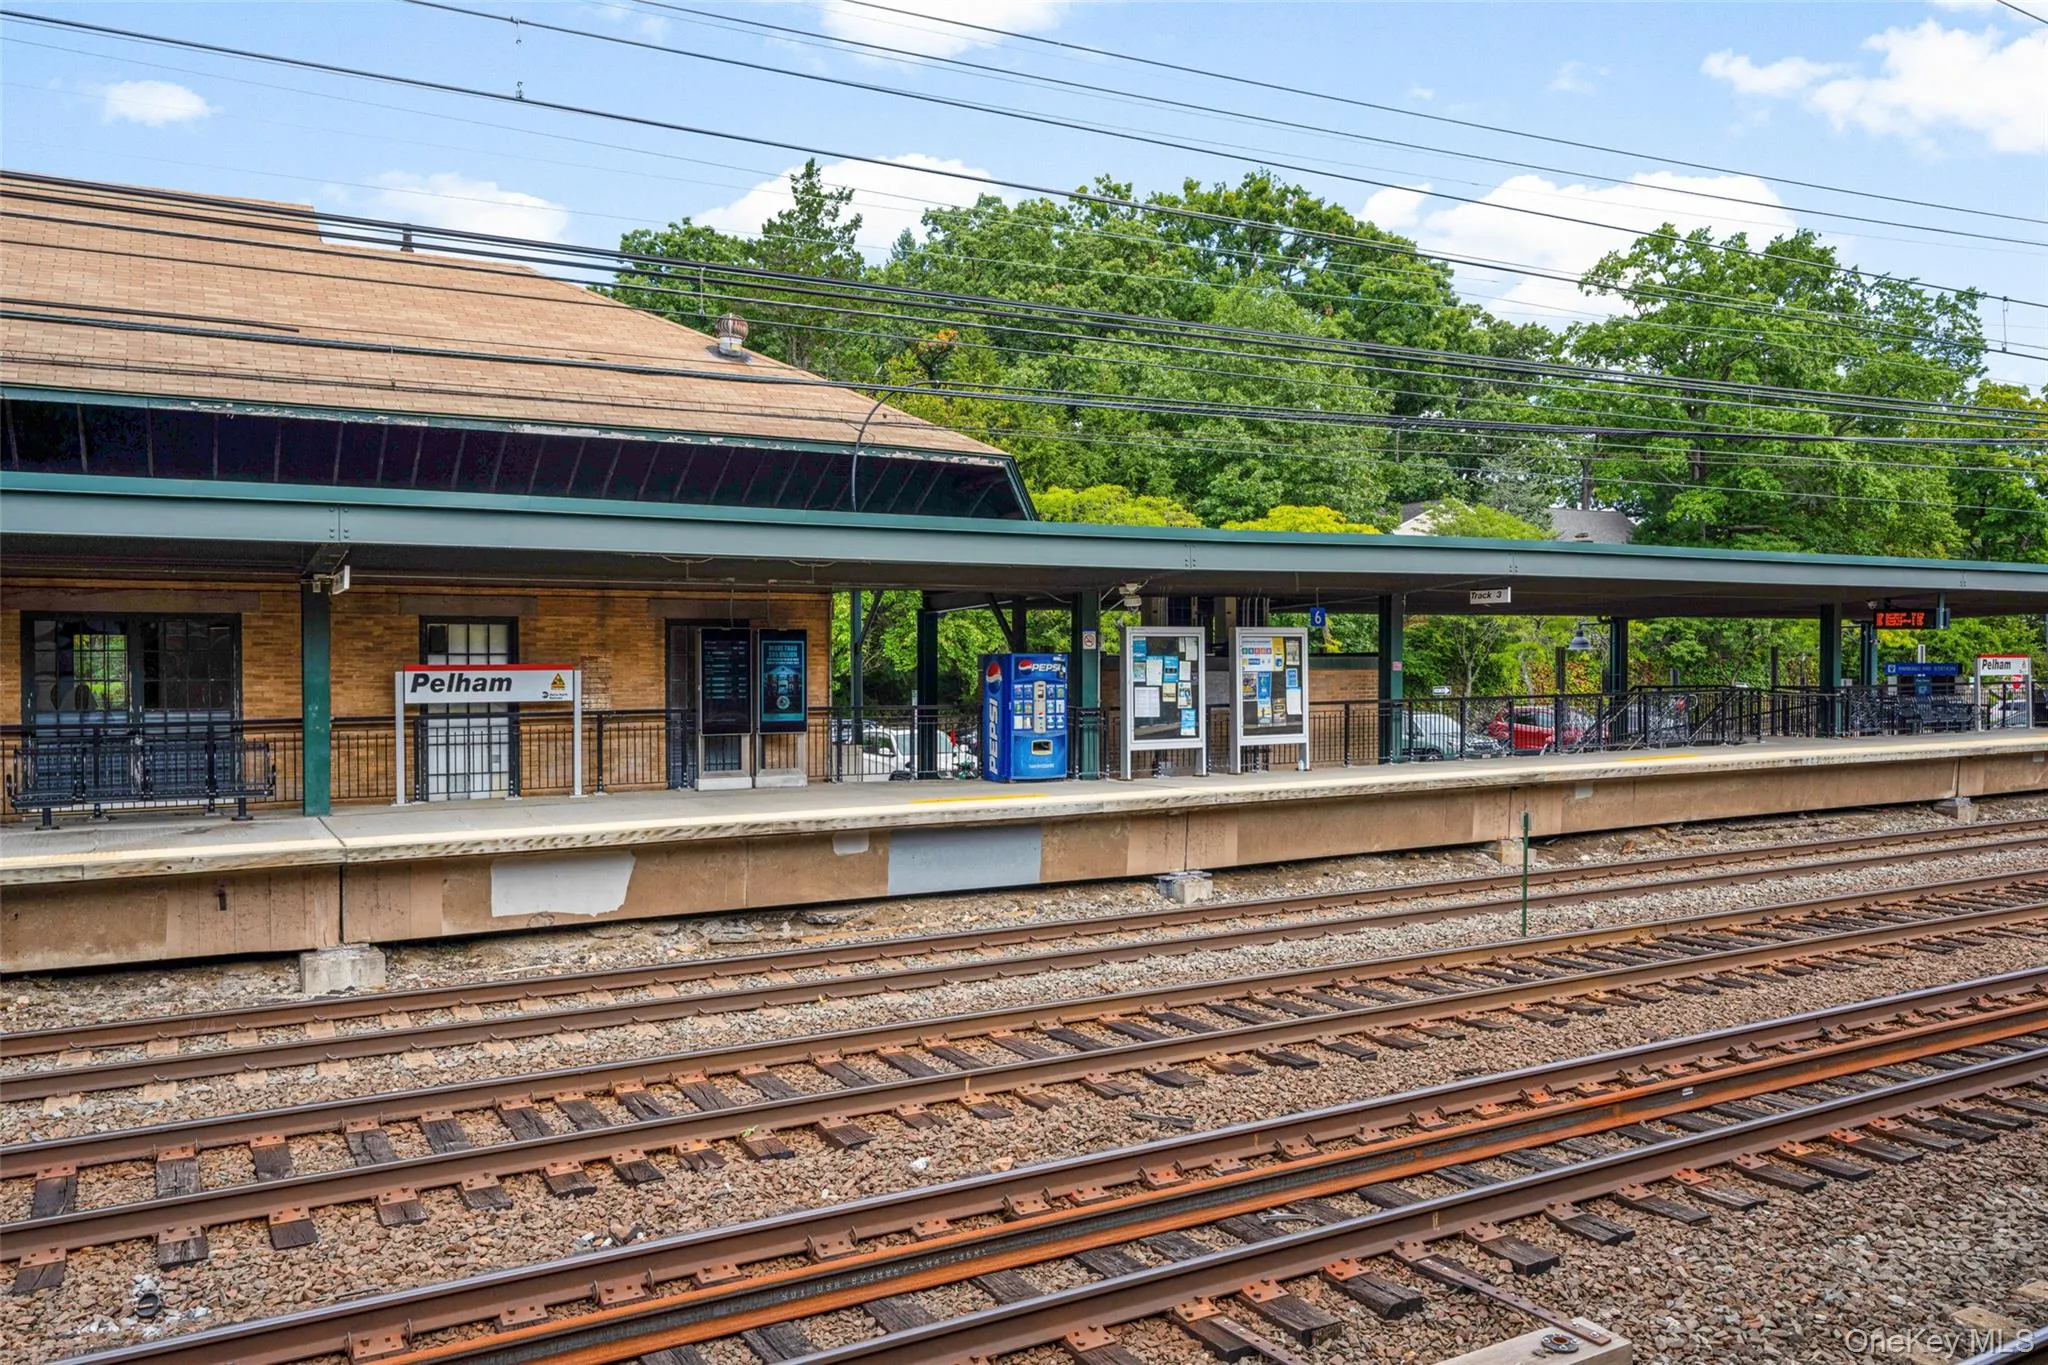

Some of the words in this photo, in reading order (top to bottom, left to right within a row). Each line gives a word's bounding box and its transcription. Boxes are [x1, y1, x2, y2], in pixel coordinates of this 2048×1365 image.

[1471, 591, 1492, 600] Track
[1496, 590, 1502, 599] 3
[1314, 610, 1322, 624] 6
[1032, 663, 1061, 672] PEPSI
[1981, 658, 2012, 670] Pelham
[410, 672, 513, 693] Pelham
[988, 697, 999, 775] PEPSI
